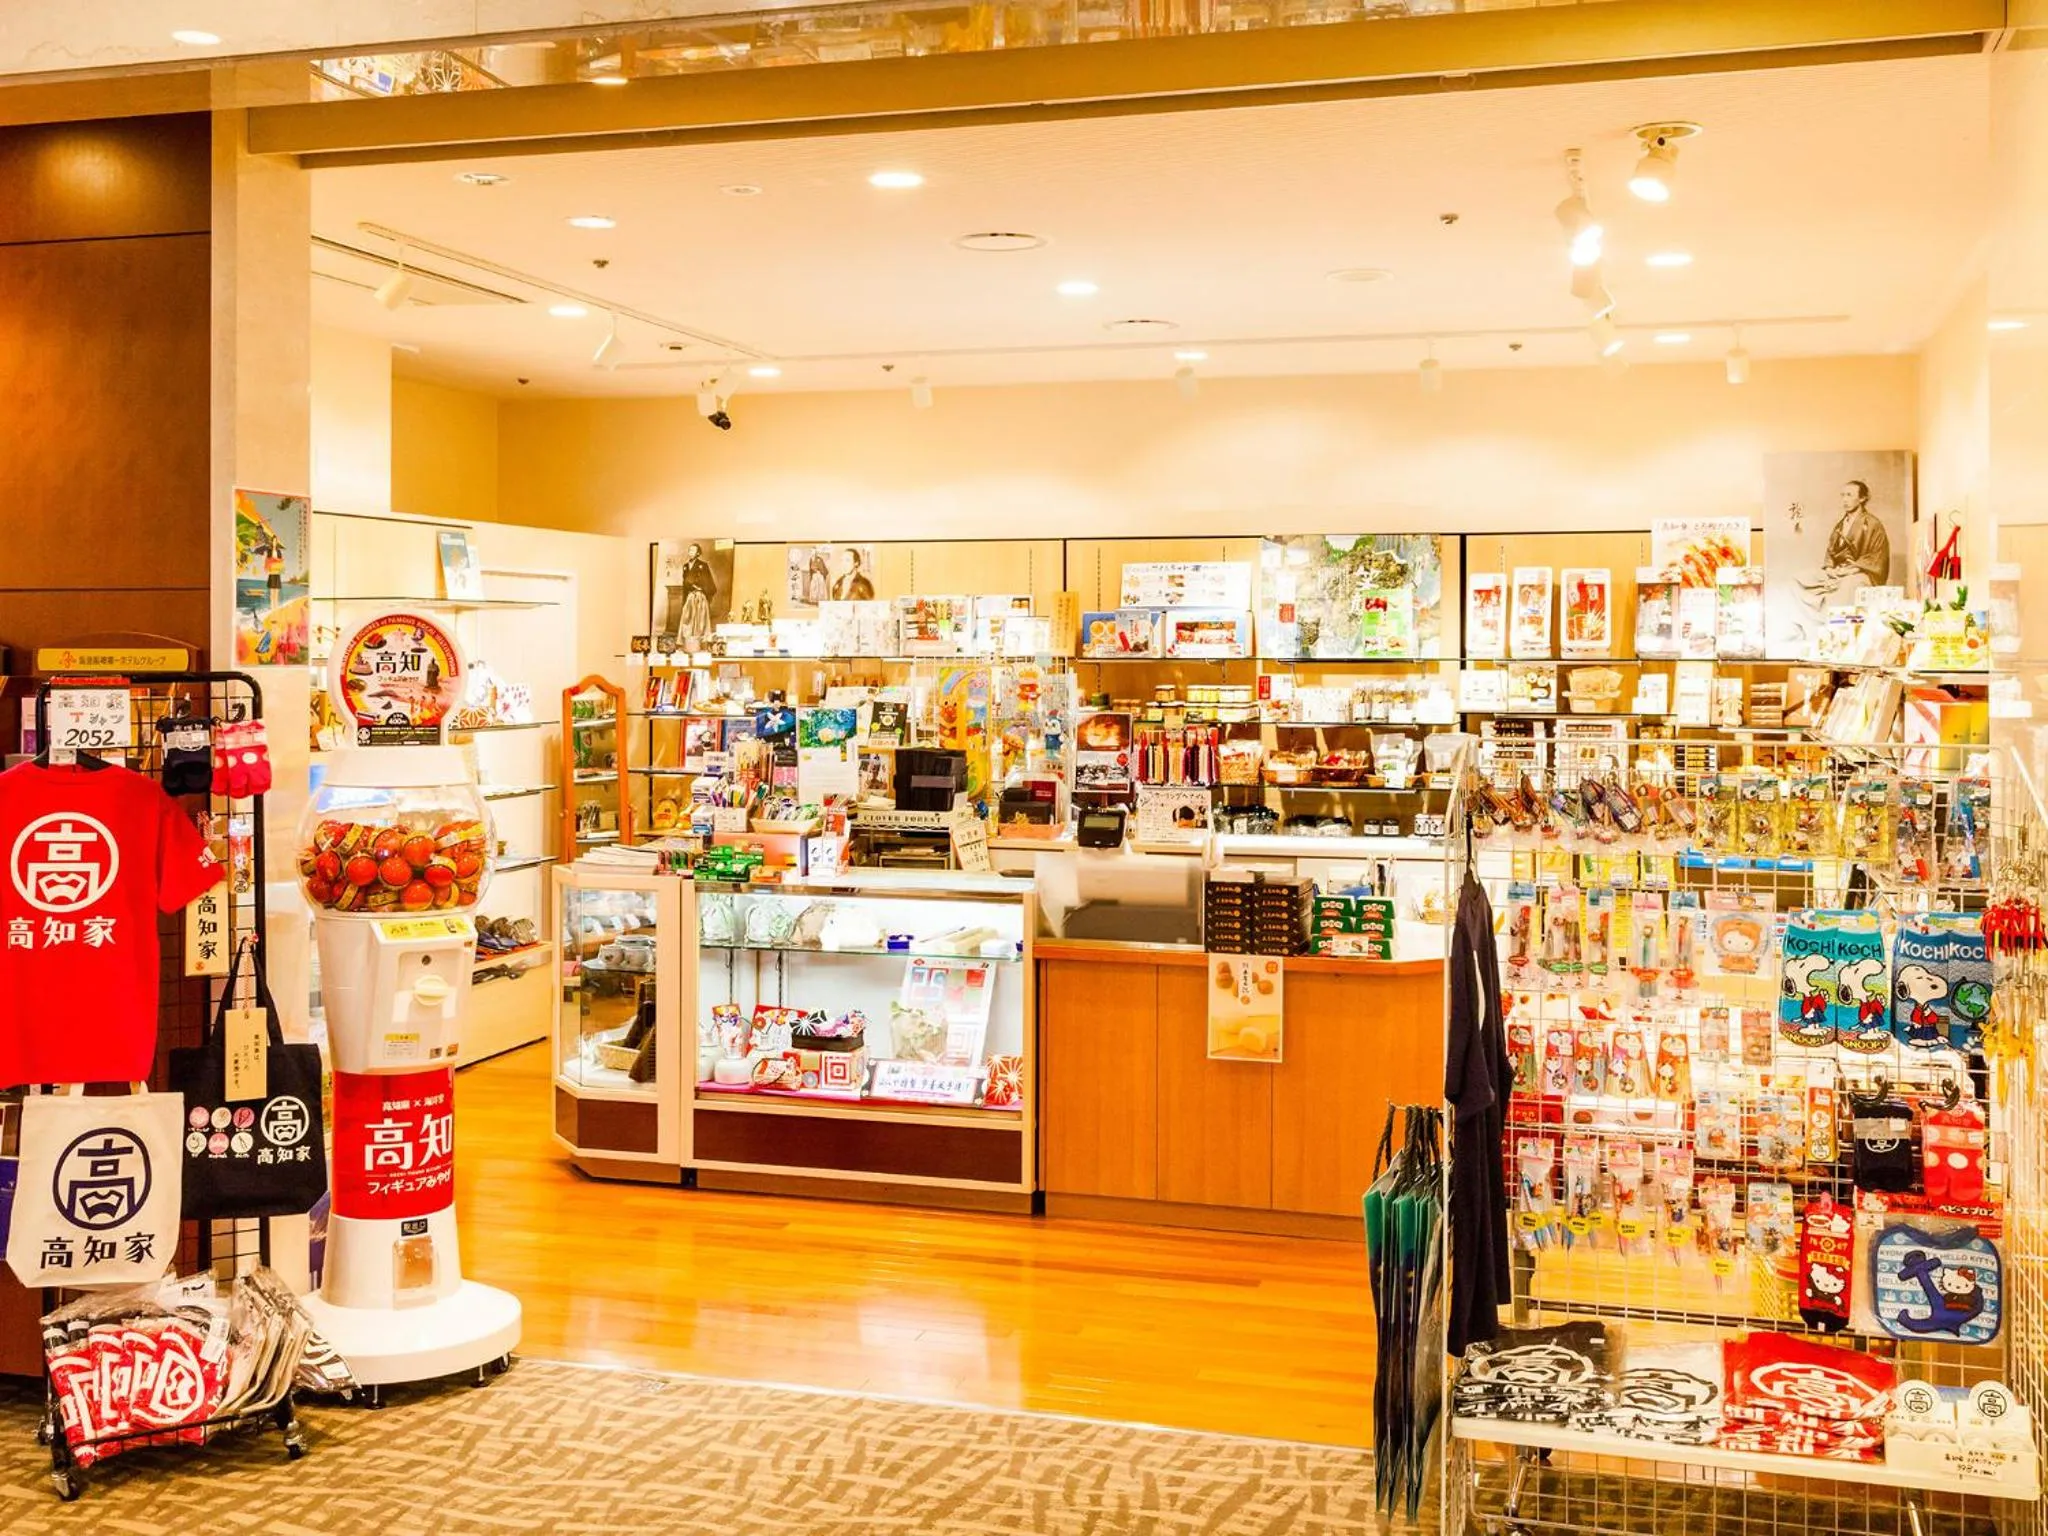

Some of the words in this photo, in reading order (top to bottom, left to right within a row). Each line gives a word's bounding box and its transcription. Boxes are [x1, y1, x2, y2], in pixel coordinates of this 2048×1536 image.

[375, 651, 421, 674] 高知
[7, 915, 118, 950] 高知家
[198, 895, 218, 960] 高知家
[1786, 934, 1836, 955] KOCHI
[1899, 939, 1949, 960] KOCHI
[1843, 1038, 1889, 1050] SNOOPY
[364, 1112, 453, 1171] 高知
[257, 1145, 311, 1165] 高知家
[367, 1167, 452, 1195] フィギュアみやげ
[40, 1231, 156, 1269] 高知家
